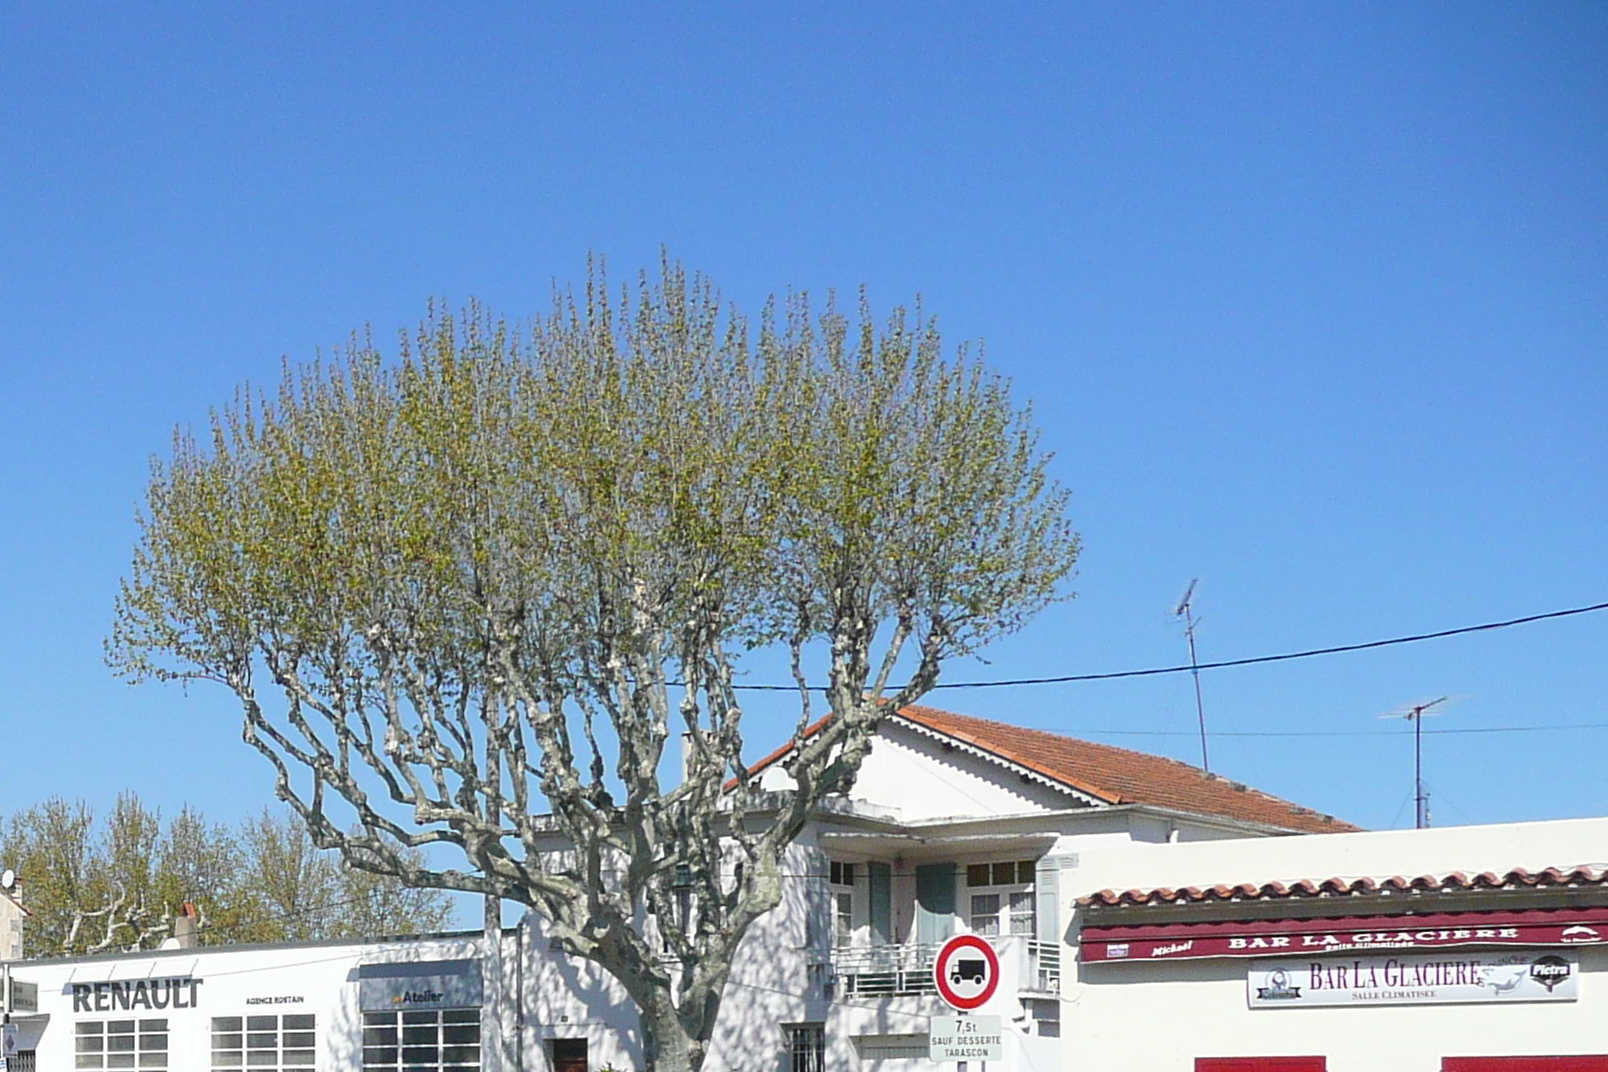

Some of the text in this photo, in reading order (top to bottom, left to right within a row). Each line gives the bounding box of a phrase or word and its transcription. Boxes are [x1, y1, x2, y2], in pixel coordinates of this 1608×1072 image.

[1228, 936, 1290, 949] BAR
[1301, 933, 1340, 947] LA
[1309, 962, 1348, 990] BAR
[1352, 960, 1378, 988] LA
[1533, 965, 1568, 976] Pietra
[70, 978, 204, 1013] RENAULT
[402, 990, 443, 1003] Atelier
[1351, 991, 1380, 1001] SALLE
[955, 1020, 977, 1034] 7,5t
[932, 1036, 1001, 1045] SAUF DESSERTE
[945, 1048, 989, 1057] TARASCON
